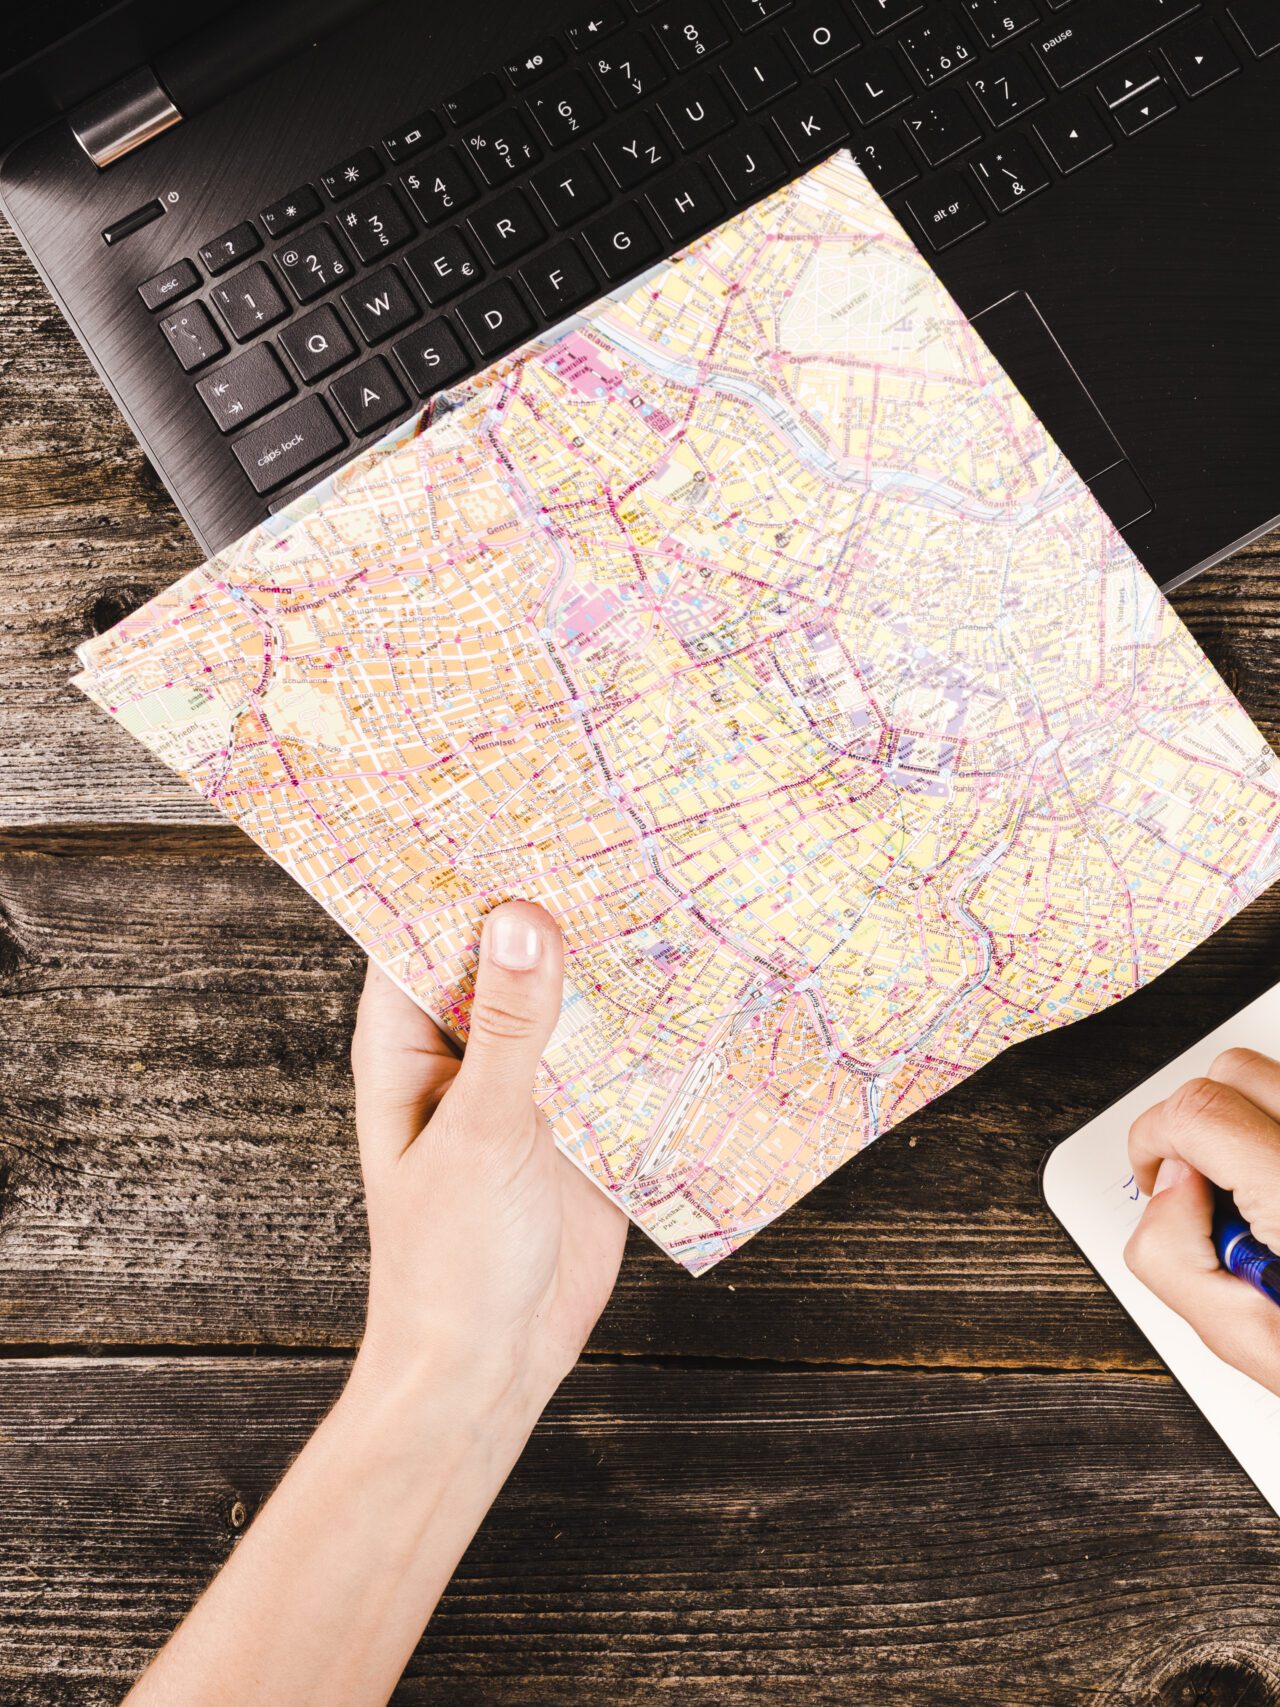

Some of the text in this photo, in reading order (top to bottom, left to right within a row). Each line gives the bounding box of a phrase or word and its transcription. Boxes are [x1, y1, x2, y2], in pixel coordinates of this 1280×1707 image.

[683, 25, 698, 41] 8
[1003, 18, 1015, 30] §
[813, 27, 831, 45] O
[1042, 28, 1073, 52] pause
[940, 46, 969, 69] ô ů
[598, 60, 611, 73] &
[620, 62, 630, 79] 7
[754, 66, 764, 82] I
[865, 82, 883, 98] L
[557, 101, 572, 117] 6
[686, 101, 705, 121] U
[801, 116, 821, 136] K
[471, 135, 509, 155] % 5
[622, 140, 661, 164] Y Z
[746, 155, 755, 173] J
[408, 176, 420, 189] $
[434, 178, 446, 193] 4
[560, 179, 575, 197] T
[1012, 182, 1026, 195] &
[674, 192, 695, 213] H
[933, 202, 960, 222] alt gr
[346, 213, 358, 226] #
[369, 216, 383, 232] 3
[497, 219, 516, 239] R
[613, 232, 631, 250] G
[282, 250, 298, 266] @
[306, 254, 321, 272] 2
[434, 256, 474, 276] E €
[161, 278, 178, 293] esc
[550, 270, 563, 290] F
[244, 293, 256, 308] 1
[366, 292, 390, 316] W
[484, 310, 503, 330] D
[308, 334, 328, 352] Q
[424, 348, 440, 366] S
[363, 388, 380, 407] A
[257, 434, 304, 467] caps lock
[618, 469, 657, 501] Alserbach
[281, 584, 357, 615] Währinger Straße
[252, 652, 272, 695] Gersthofer
[903, 728, 925, 738] Burg
[649, 801, 741, 835] Lerchenfelder Straße
[581, 838, 634, 861] Thaliastraße
[690, 867, 728, 894] Burggasse
[633, 1177, 660, 1190] Linzer
[669, 1226, 738, 1249] Linke Wienzeile
